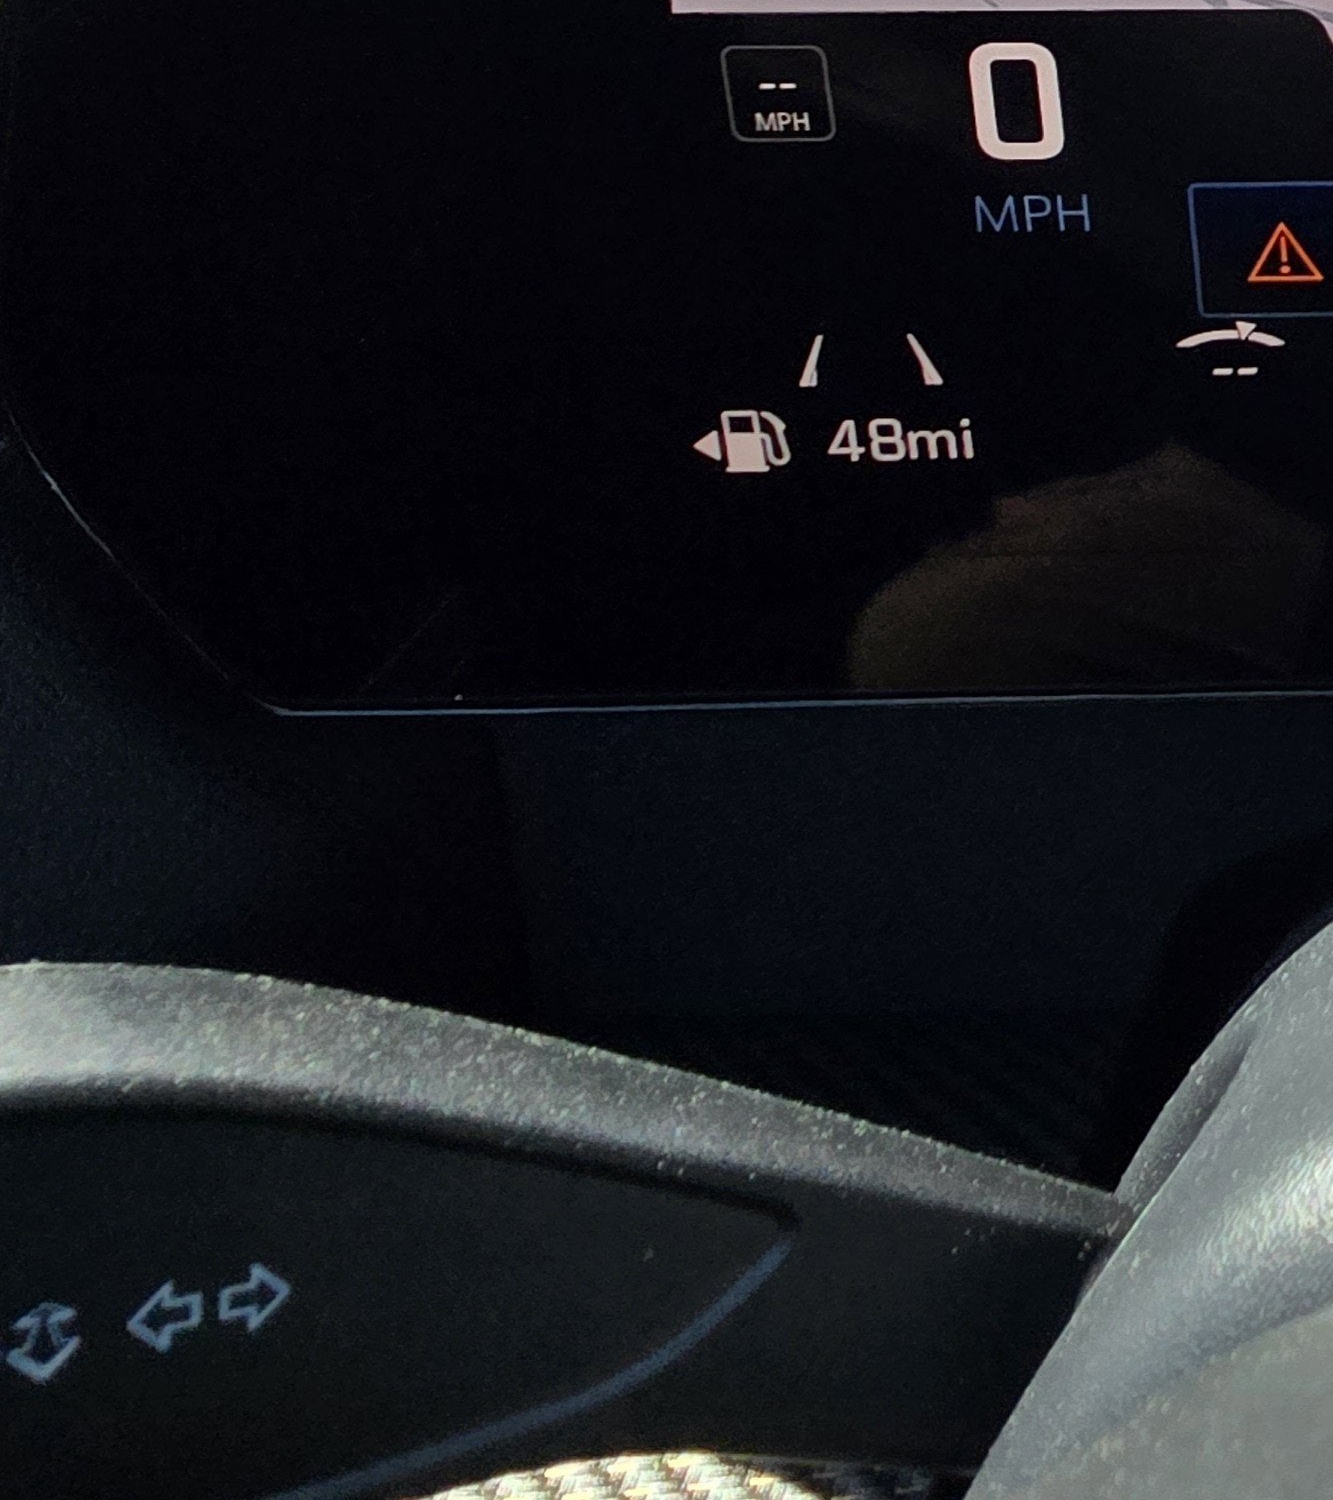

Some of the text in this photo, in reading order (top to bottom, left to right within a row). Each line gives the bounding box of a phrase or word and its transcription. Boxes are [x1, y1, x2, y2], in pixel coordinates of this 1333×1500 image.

[754, 111, 811, 133] MPH
[968, 41, 1066, 161] 0
[974, 193, 1092, 234] MPH
[827, 417, 976, 462] 48mi
